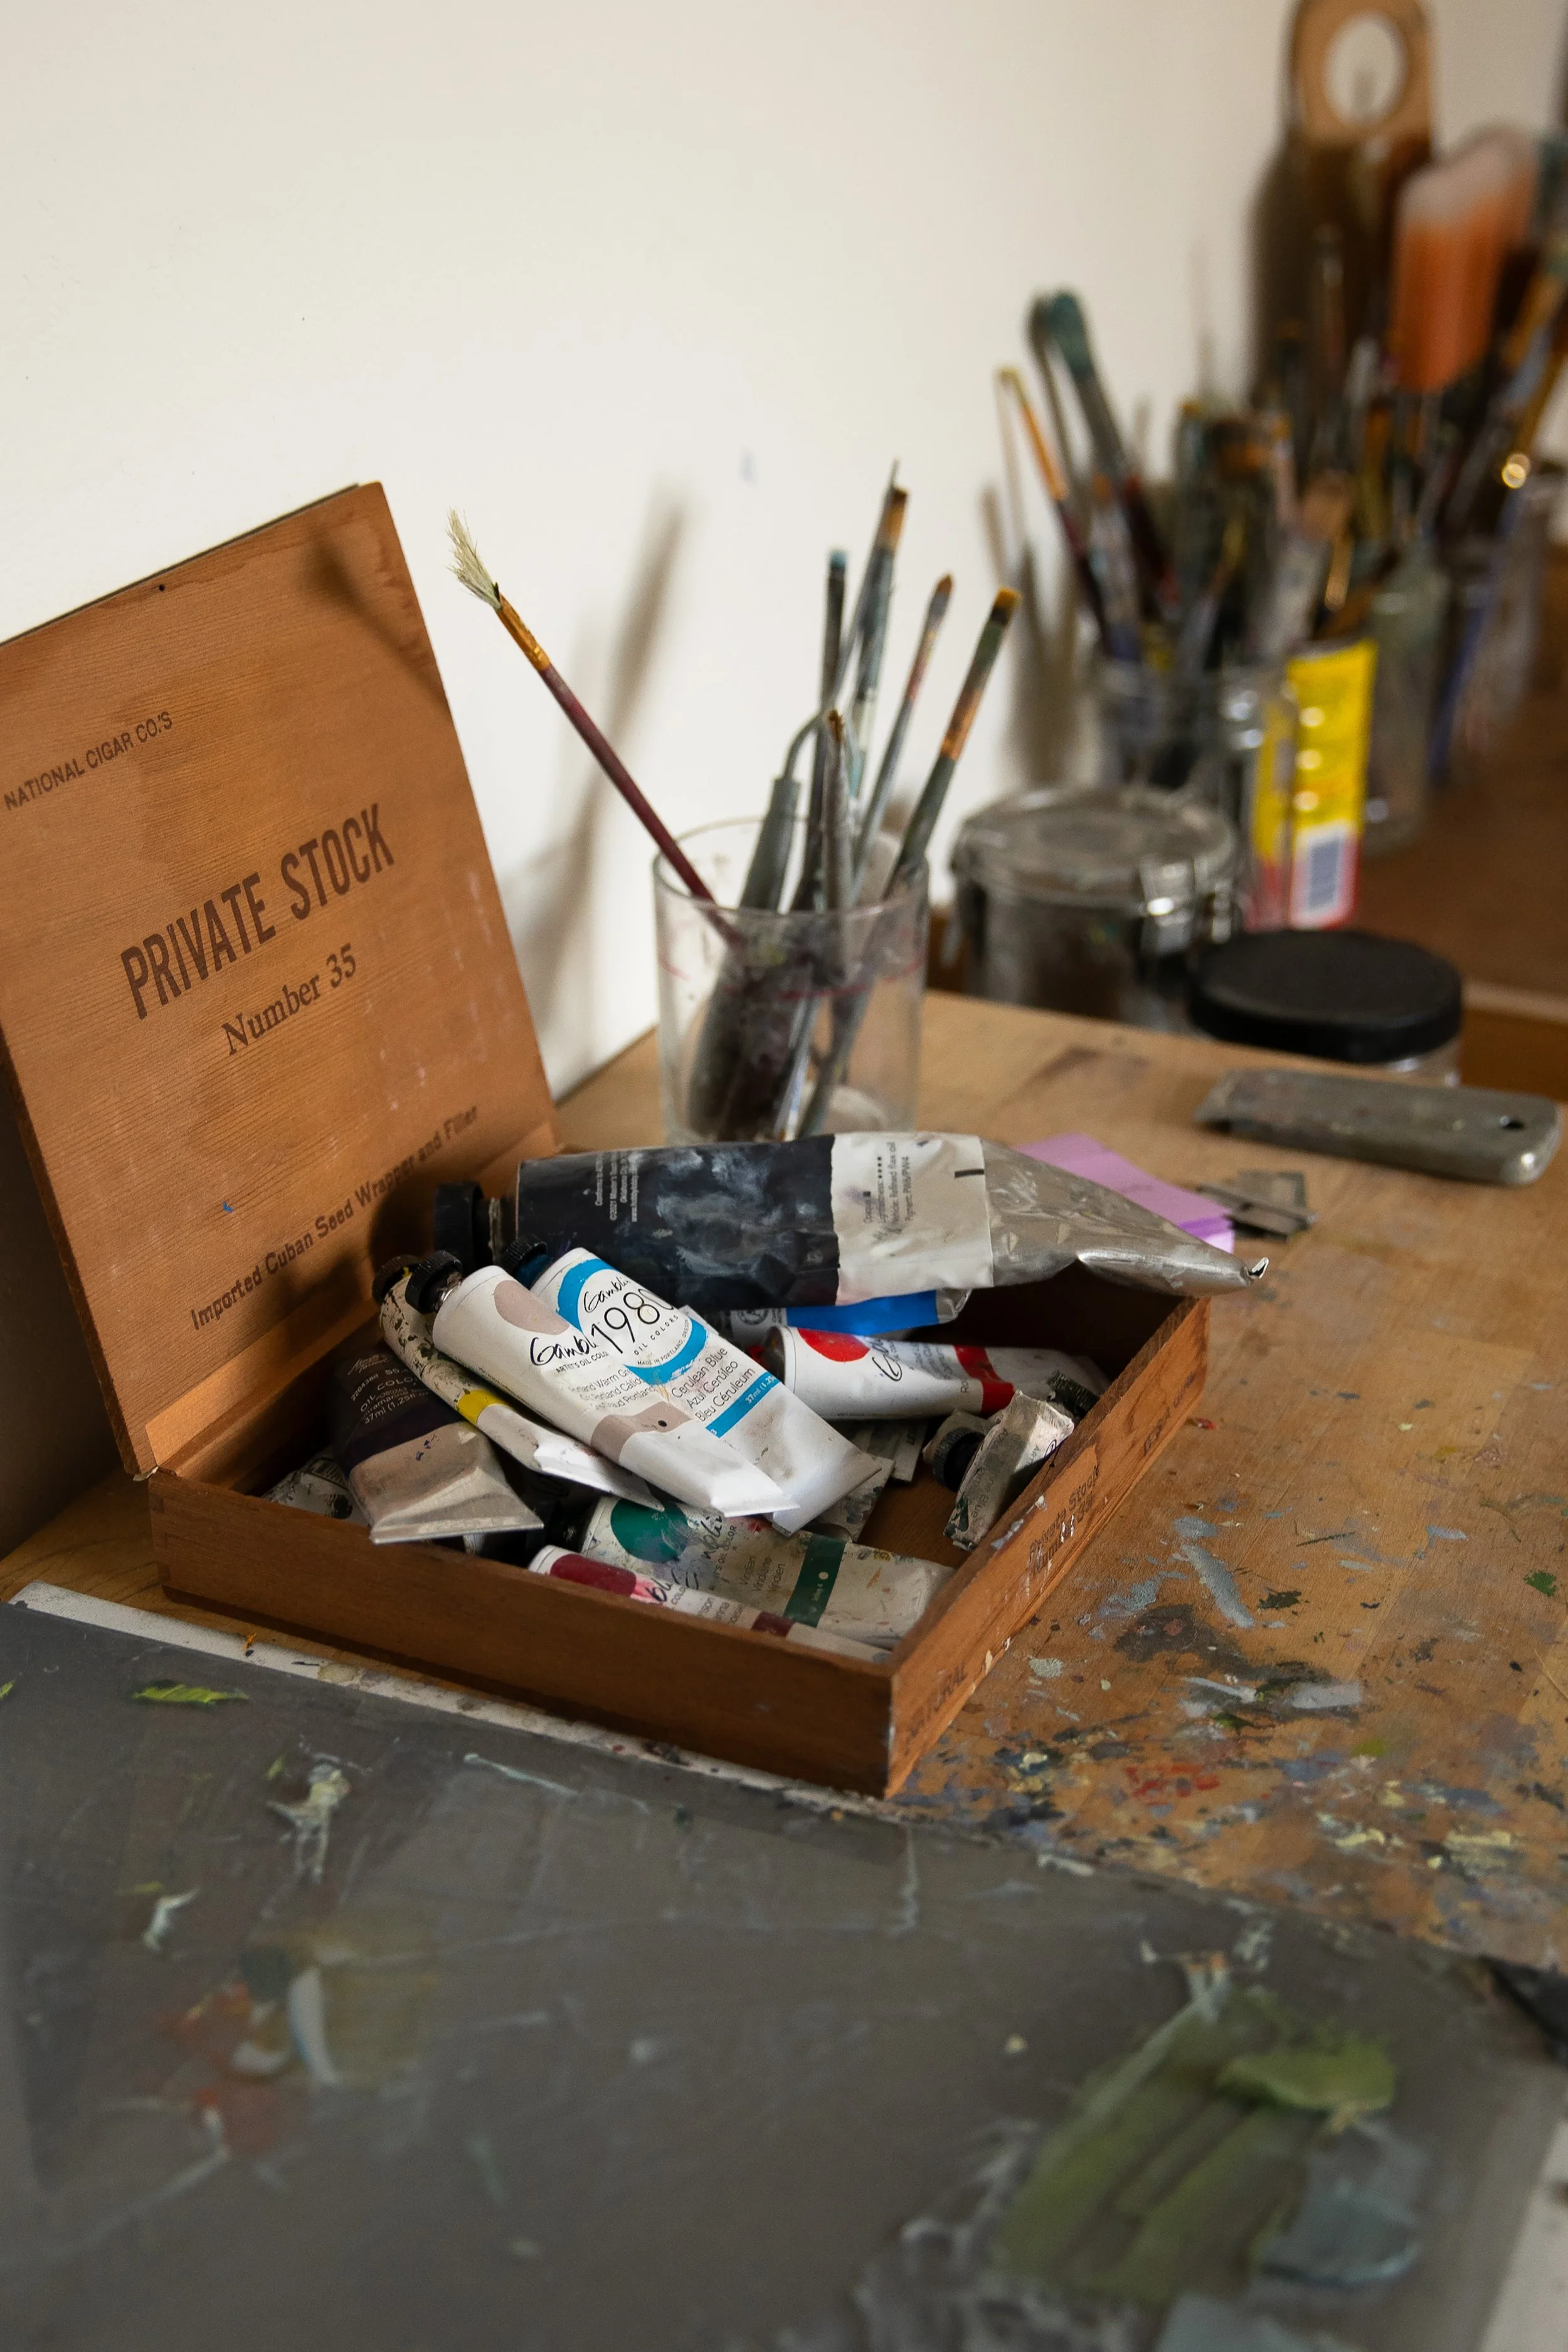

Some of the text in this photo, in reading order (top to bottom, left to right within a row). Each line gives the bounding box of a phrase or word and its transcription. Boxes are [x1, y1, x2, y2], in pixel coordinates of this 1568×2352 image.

[4, 758, 85, 810] NATIONAL
[86, 733, 134, 769] CIGAR
[120, 803, 395, 1020] PRIVATE STOCK
[221, 943, 357, 1056] Number 35
[191, 1266, 262, 1330] Imported
[265, 1233, 314, 1274] Cuban
[315, 1199, 354, 1238] Seed
[354, 1155, 415, 1208] Wrapper
[591, 1288, 675, 1354] 1980
[633, 1315, 679, 1355] OIL COLORS
[580, 1355, 591, 1369] OIL
[660, 1339, 686, 1362] PORTLAND,
[671, 1348, 728, 1399] Cerulean Blue
[360, 1394, 376, 1412] OIL
[594, 1374, 620, 1389] Warm
[686, 1360, 739, 1409] Azul Cerúleo
[694, 1367, 756, 1422] Bleu Céruleum
[744, 1387, 761, 1404] 37ml
[364, 1406, 386, 1424] 37ml
